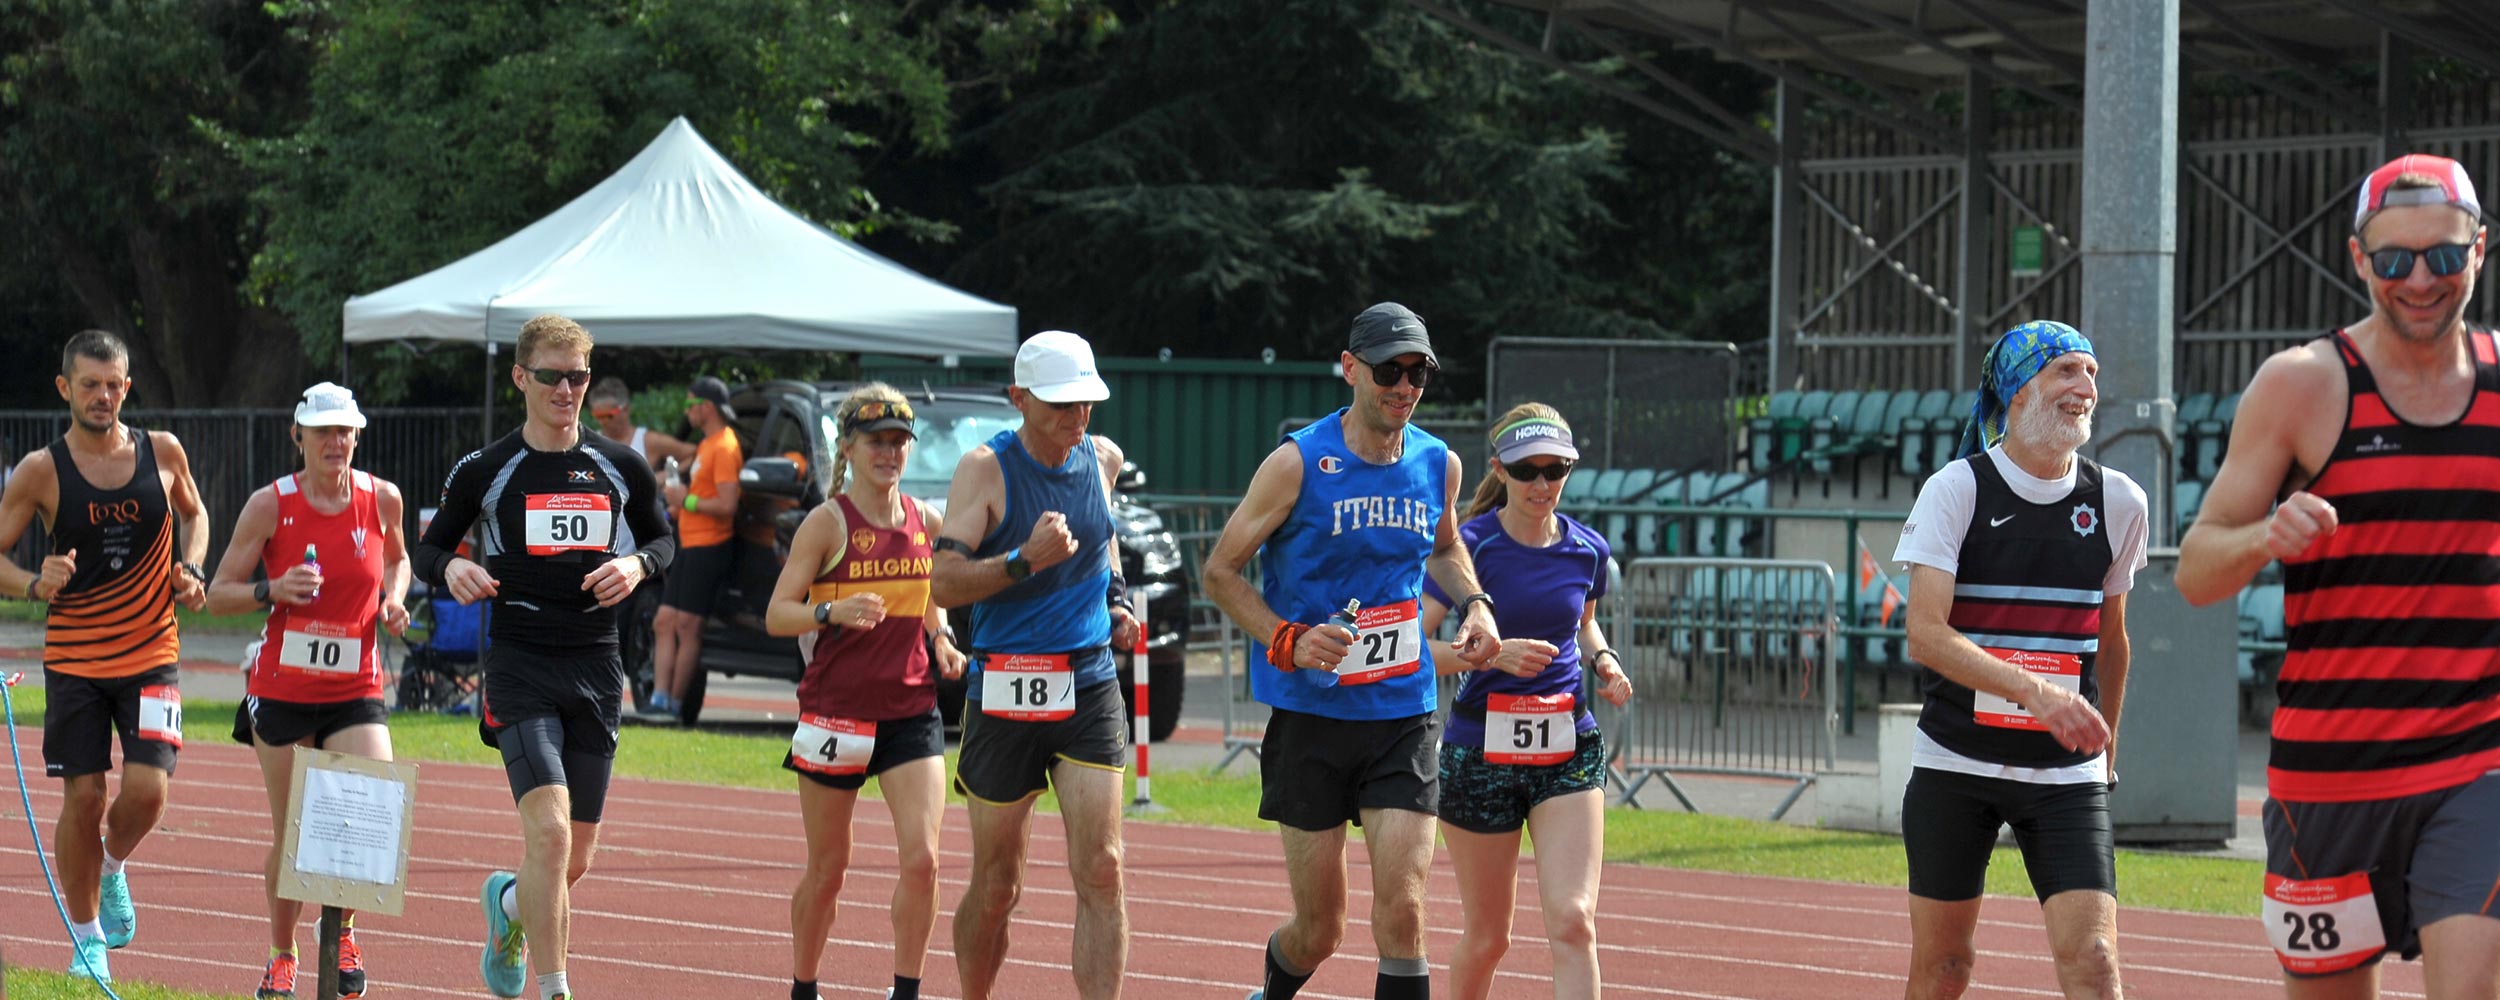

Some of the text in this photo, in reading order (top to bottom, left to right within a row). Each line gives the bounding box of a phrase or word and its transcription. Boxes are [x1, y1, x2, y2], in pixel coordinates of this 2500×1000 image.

[444, 450, 483, 489] BIONIC
[551, 515, 588, 542] 50
[1331, 496, 1429, 540] ITALIA
[849, 556, 933, 580] BELGRAV
[307, 639, 341, 668] 10
[1363, 628, 1400, 667] 27
[1010, 677, 1049, 707] 18
[819, 736, 838, 762] 4
[1513, 719, 1550, 749] 51
[2284, 911, 2340, 951] 28
